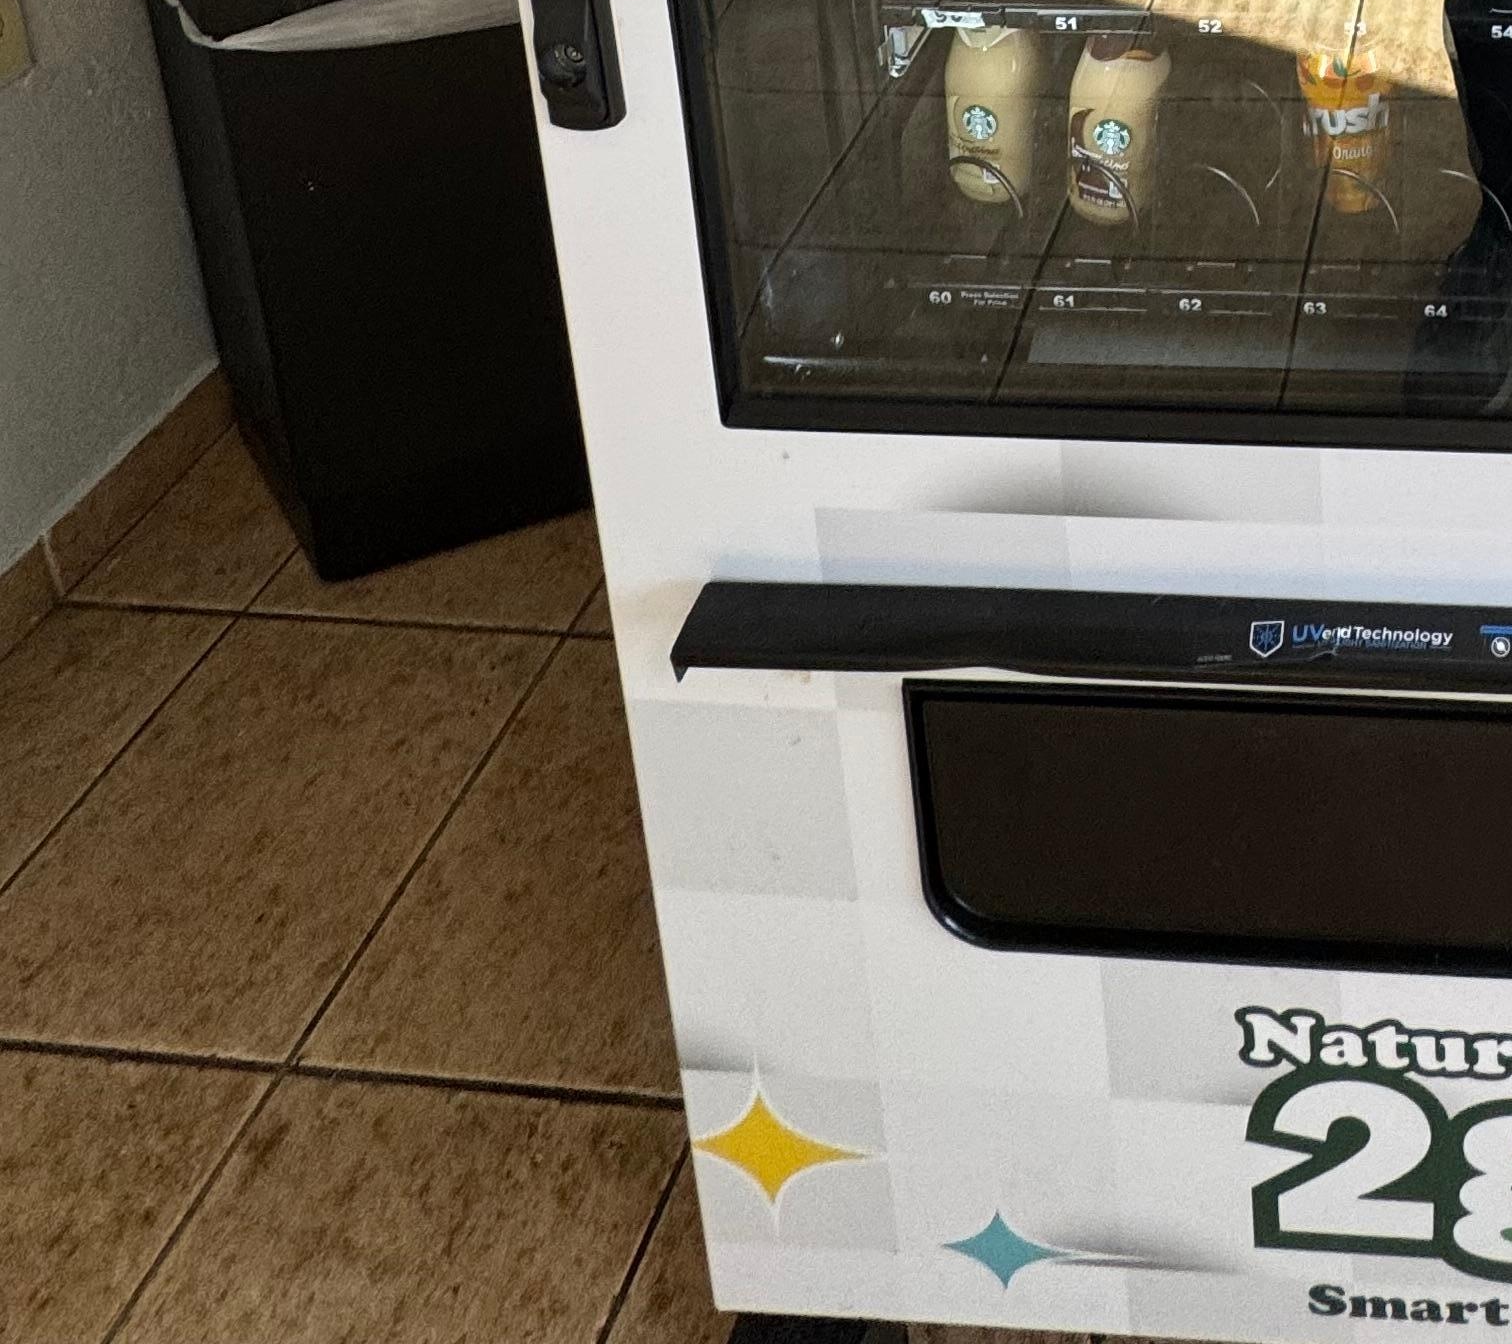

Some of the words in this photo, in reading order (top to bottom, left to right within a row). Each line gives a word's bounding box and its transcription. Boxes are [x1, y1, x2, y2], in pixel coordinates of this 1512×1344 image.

[1055, 16, 1078, 30] 51
[1198, 19, 1222, 34] 52
[928, 290, 952, 304] 60
[1053, 295, 1074, 308] 61
[1178, 298, 1202, 313] 62
[1303, 301, 1327, 315] 63
[1424, 304, 1448, 319] 64
[1354, 626, 1453, 646] Technology
[1308, 1284, 1510, 1328] Smart
